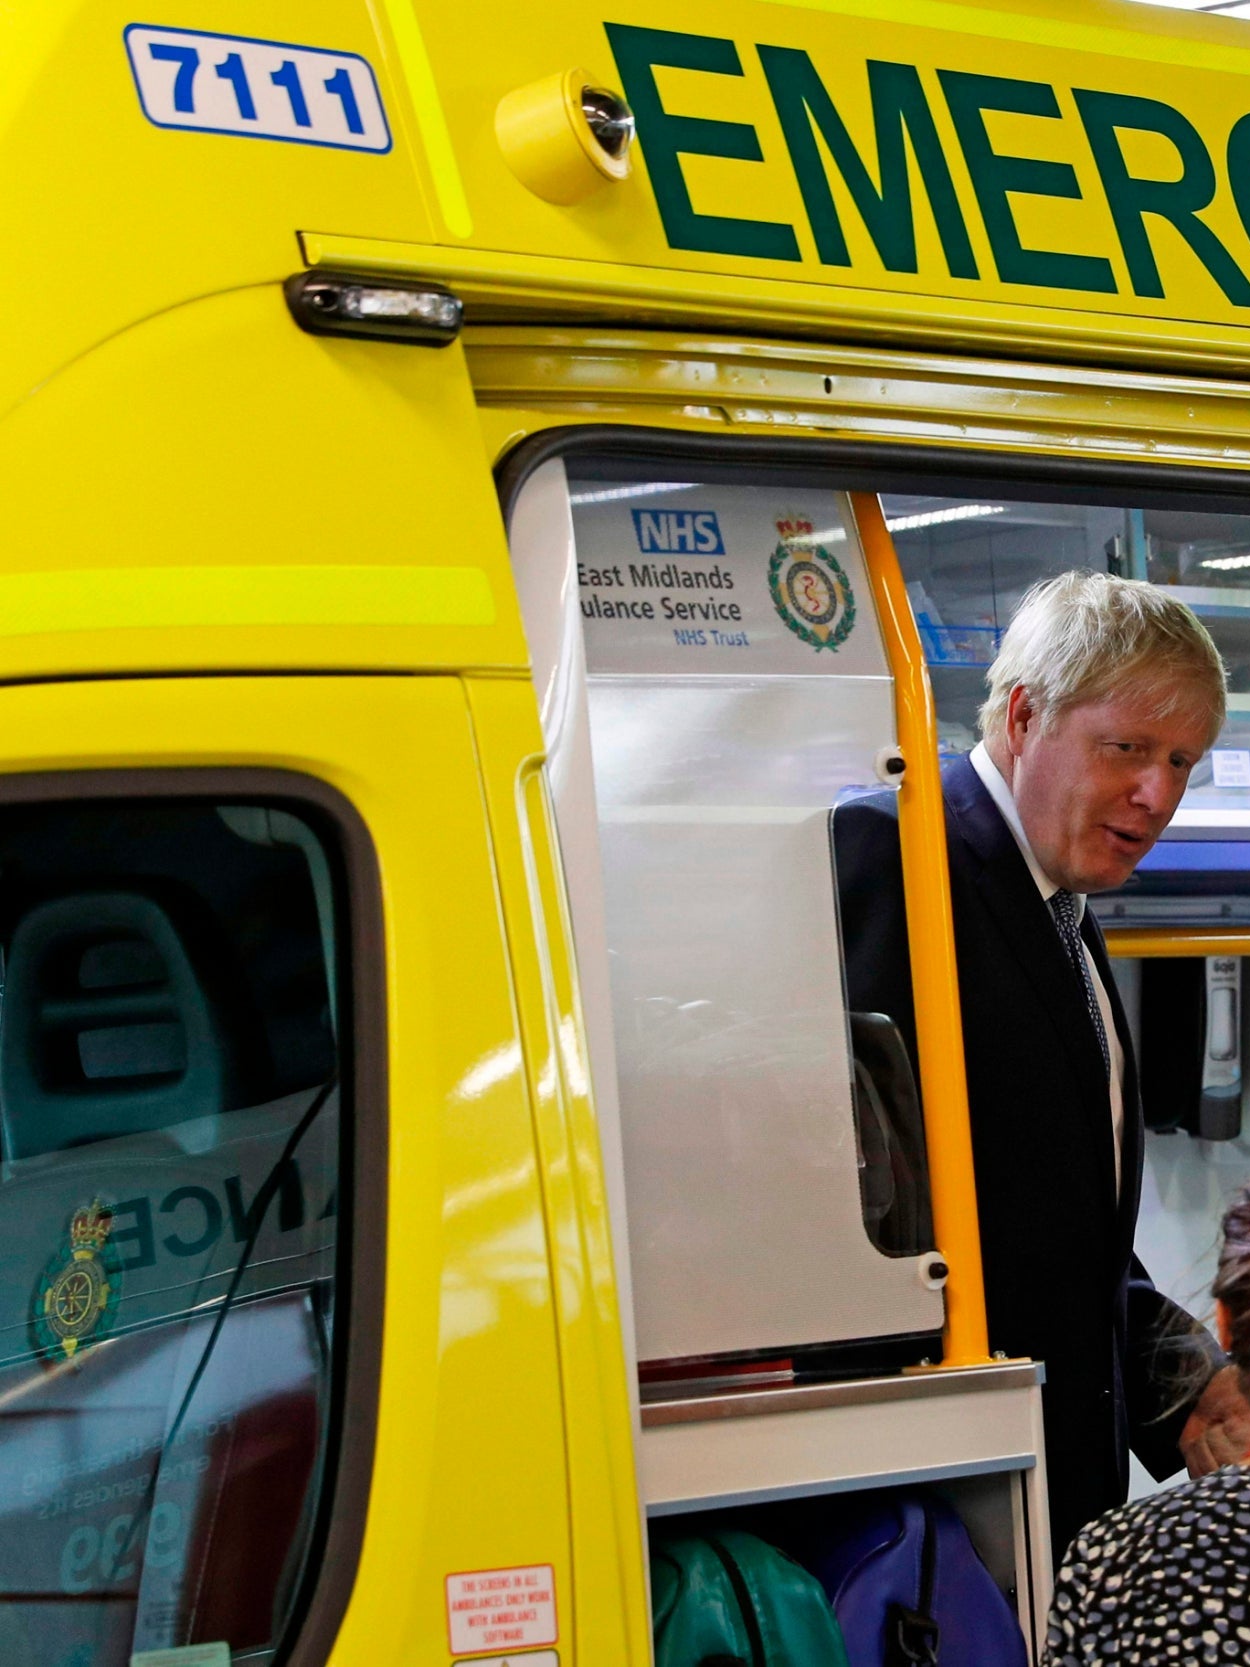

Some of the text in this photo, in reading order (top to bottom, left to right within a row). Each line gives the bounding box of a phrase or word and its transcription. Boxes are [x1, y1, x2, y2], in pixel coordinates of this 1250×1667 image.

[148, 43, 365, 136] 7111
[639, 511, 718, 552] NHS
[578, 564, 734, 590] East Midlands
[664, 597, 741, 621] Service
[673, 629, 749, 647] NHS Trust
